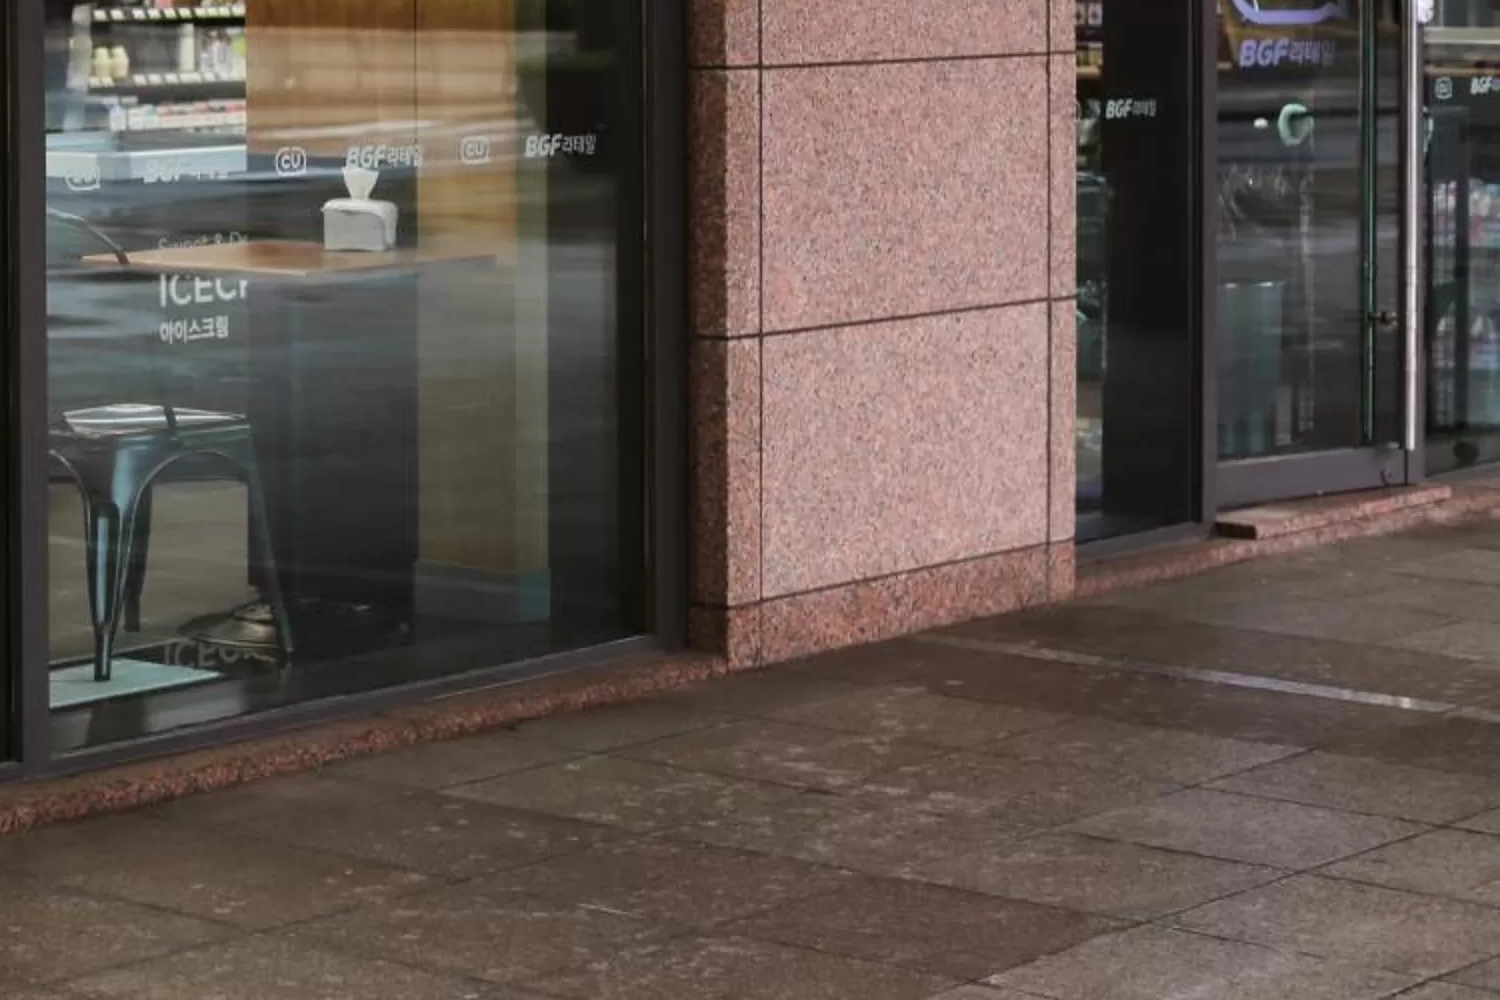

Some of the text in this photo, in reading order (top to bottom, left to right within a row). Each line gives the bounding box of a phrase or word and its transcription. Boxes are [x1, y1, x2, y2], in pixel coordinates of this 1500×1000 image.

[347, 146, 422, 168] BGF리테일
[524, 133, 596, 158] BGF리테일
[160, 315, 228, 344] 아이스크림
